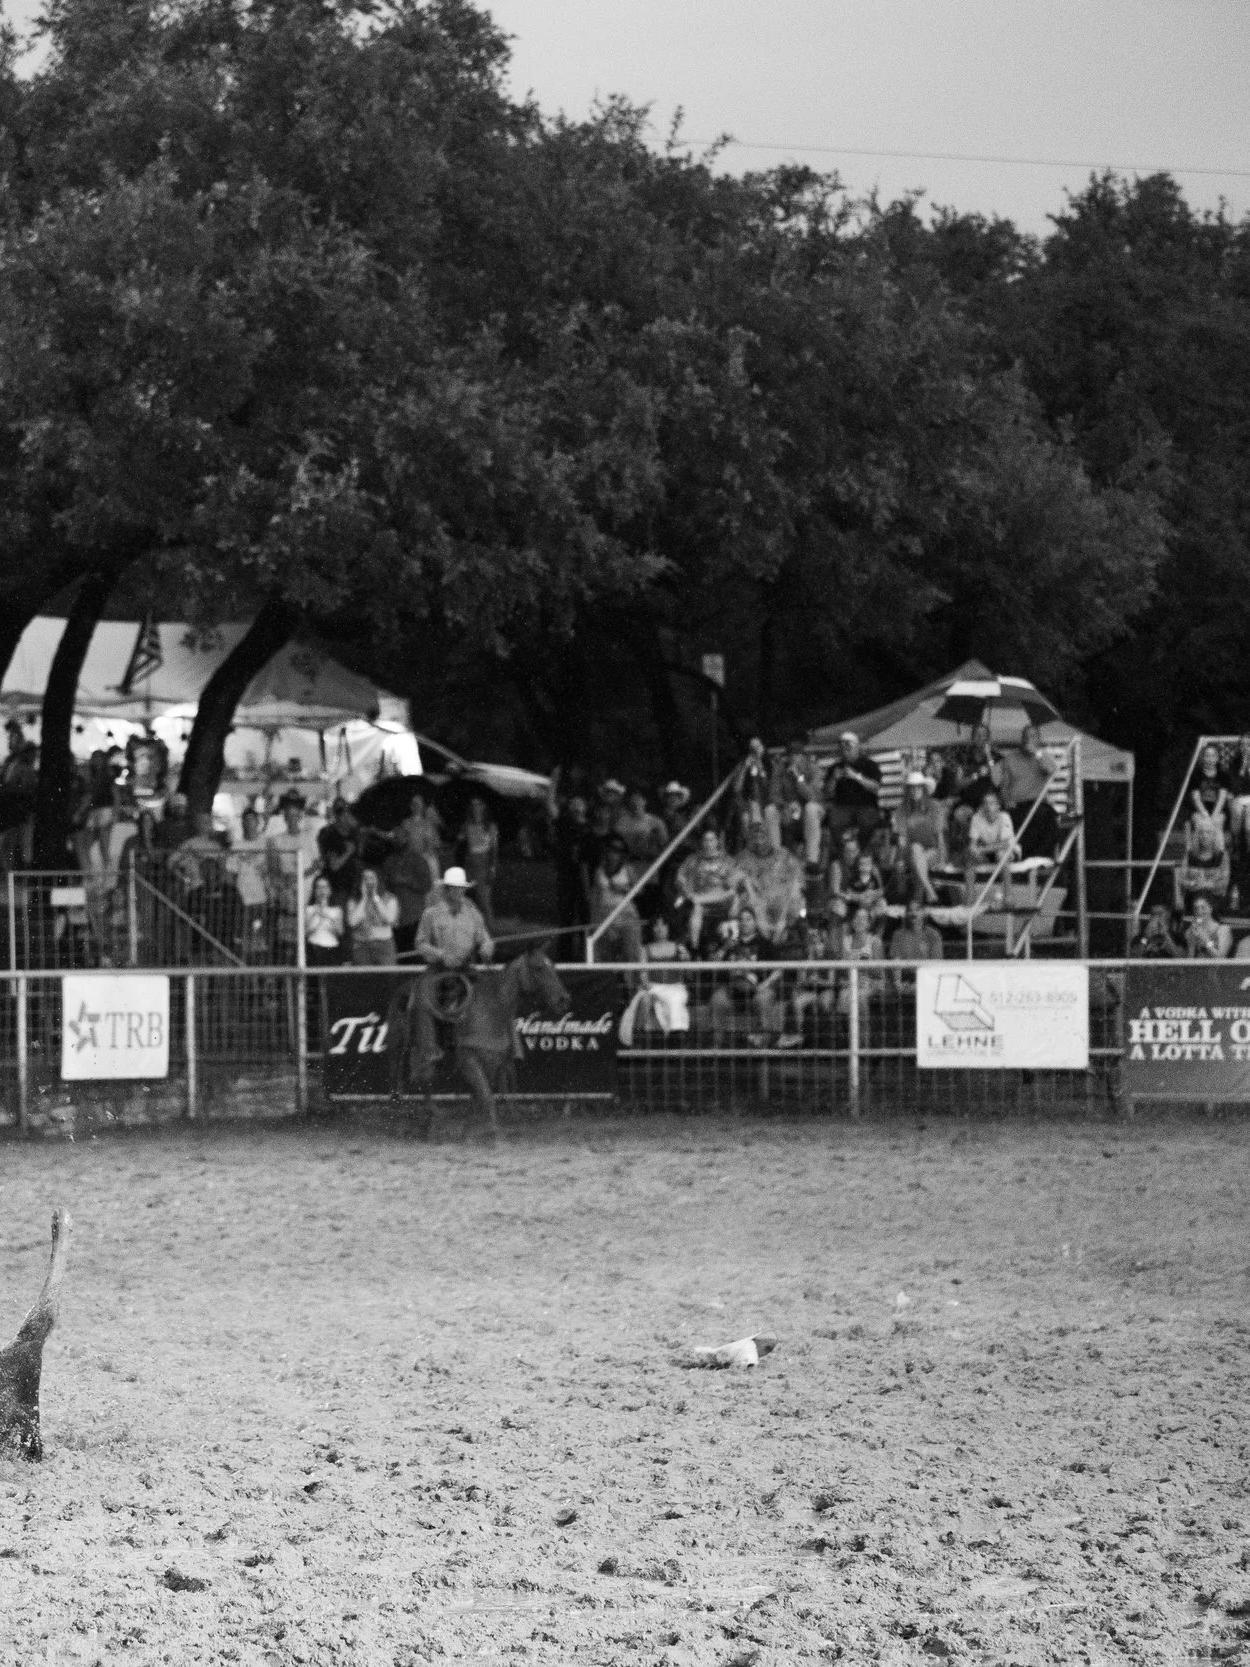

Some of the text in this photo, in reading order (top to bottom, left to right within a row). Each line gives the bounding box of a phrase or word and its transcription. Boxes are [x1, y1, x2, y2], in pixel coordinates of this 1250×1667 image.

[1139, 1006, 1150, 1019] A
[1154, 1006, 1208, 1019] VODKA
[105, 1011, 163, 1049] TRB
[1128, 1019, 1222, 1044] HELL
[525, 1036, 600, 1051] VODKA
[1130, 1043, 1145, 1060] A
[1152, 1043, 1224, 1060] LOTTA
